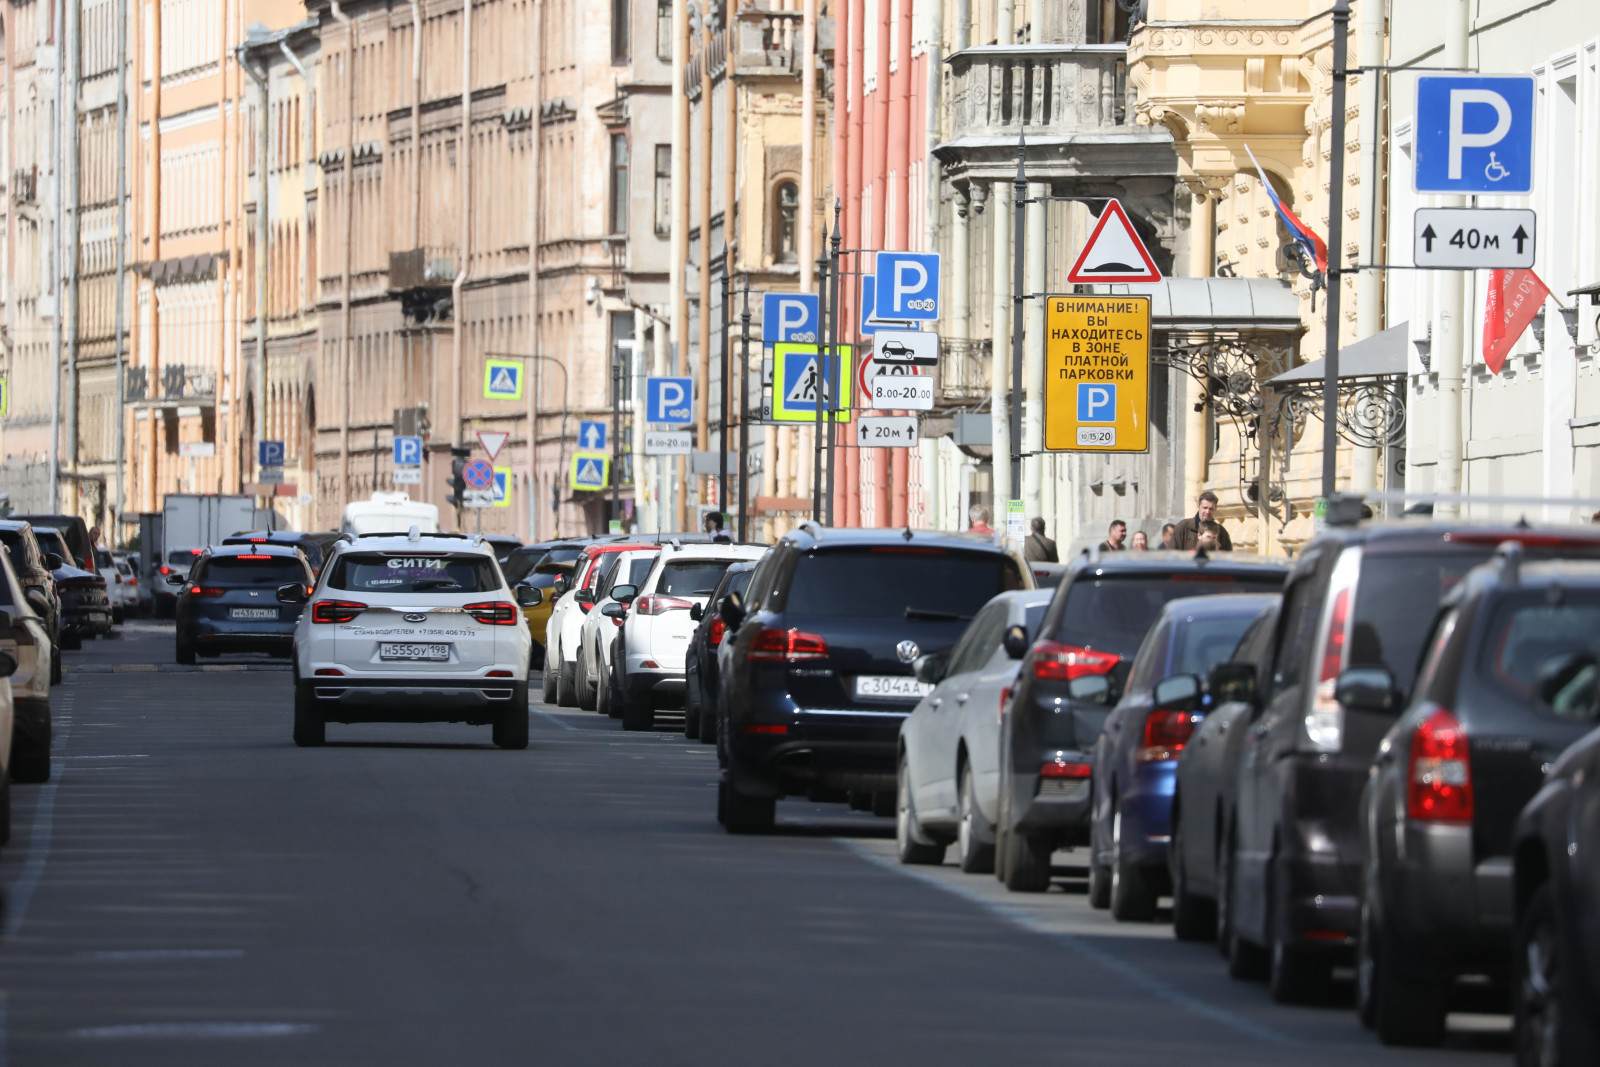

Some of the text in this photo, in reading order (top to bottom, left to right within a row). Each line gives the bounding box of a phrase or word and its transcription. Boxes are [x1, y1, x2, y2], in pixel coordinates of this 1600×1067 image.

[1448, 89, 1513, 180] P
[893, 260, 929, 312] P
[915, 301, 924, 309] 15
[924, 301, 935, 309] 20
[1056, 302, 1139, 313] ВНИМАНИЕ!
[778, 300, 809, 342] P
[1087, 316, 1108, 326] ВЫ
[1052, 329, 1143, 341] НАХОДИТЕСЬ
[1072, 343, 1120, 353] В ЗОНЕ
[1065, 353, 1128, 366] ПЛАТНОЙ
[1060, 369, 1134, 380] ПАРКОВКИ
[876, 387, 931, 399] 8.00-20.00
[659, 382, 684, 419] P
[1088, 388, 1109, 418] P
[1089, 432, 1097, 440] 15
[1099, 432, 1111, 441] 20
[265, 444, 280, 464] P
[401, 440, 417, 462] P
[387, 558, 441, 569] СИТИ
[384, 644, 447, 656] Н555ОУ 198
[861, 678, 921, 693] С304АА
